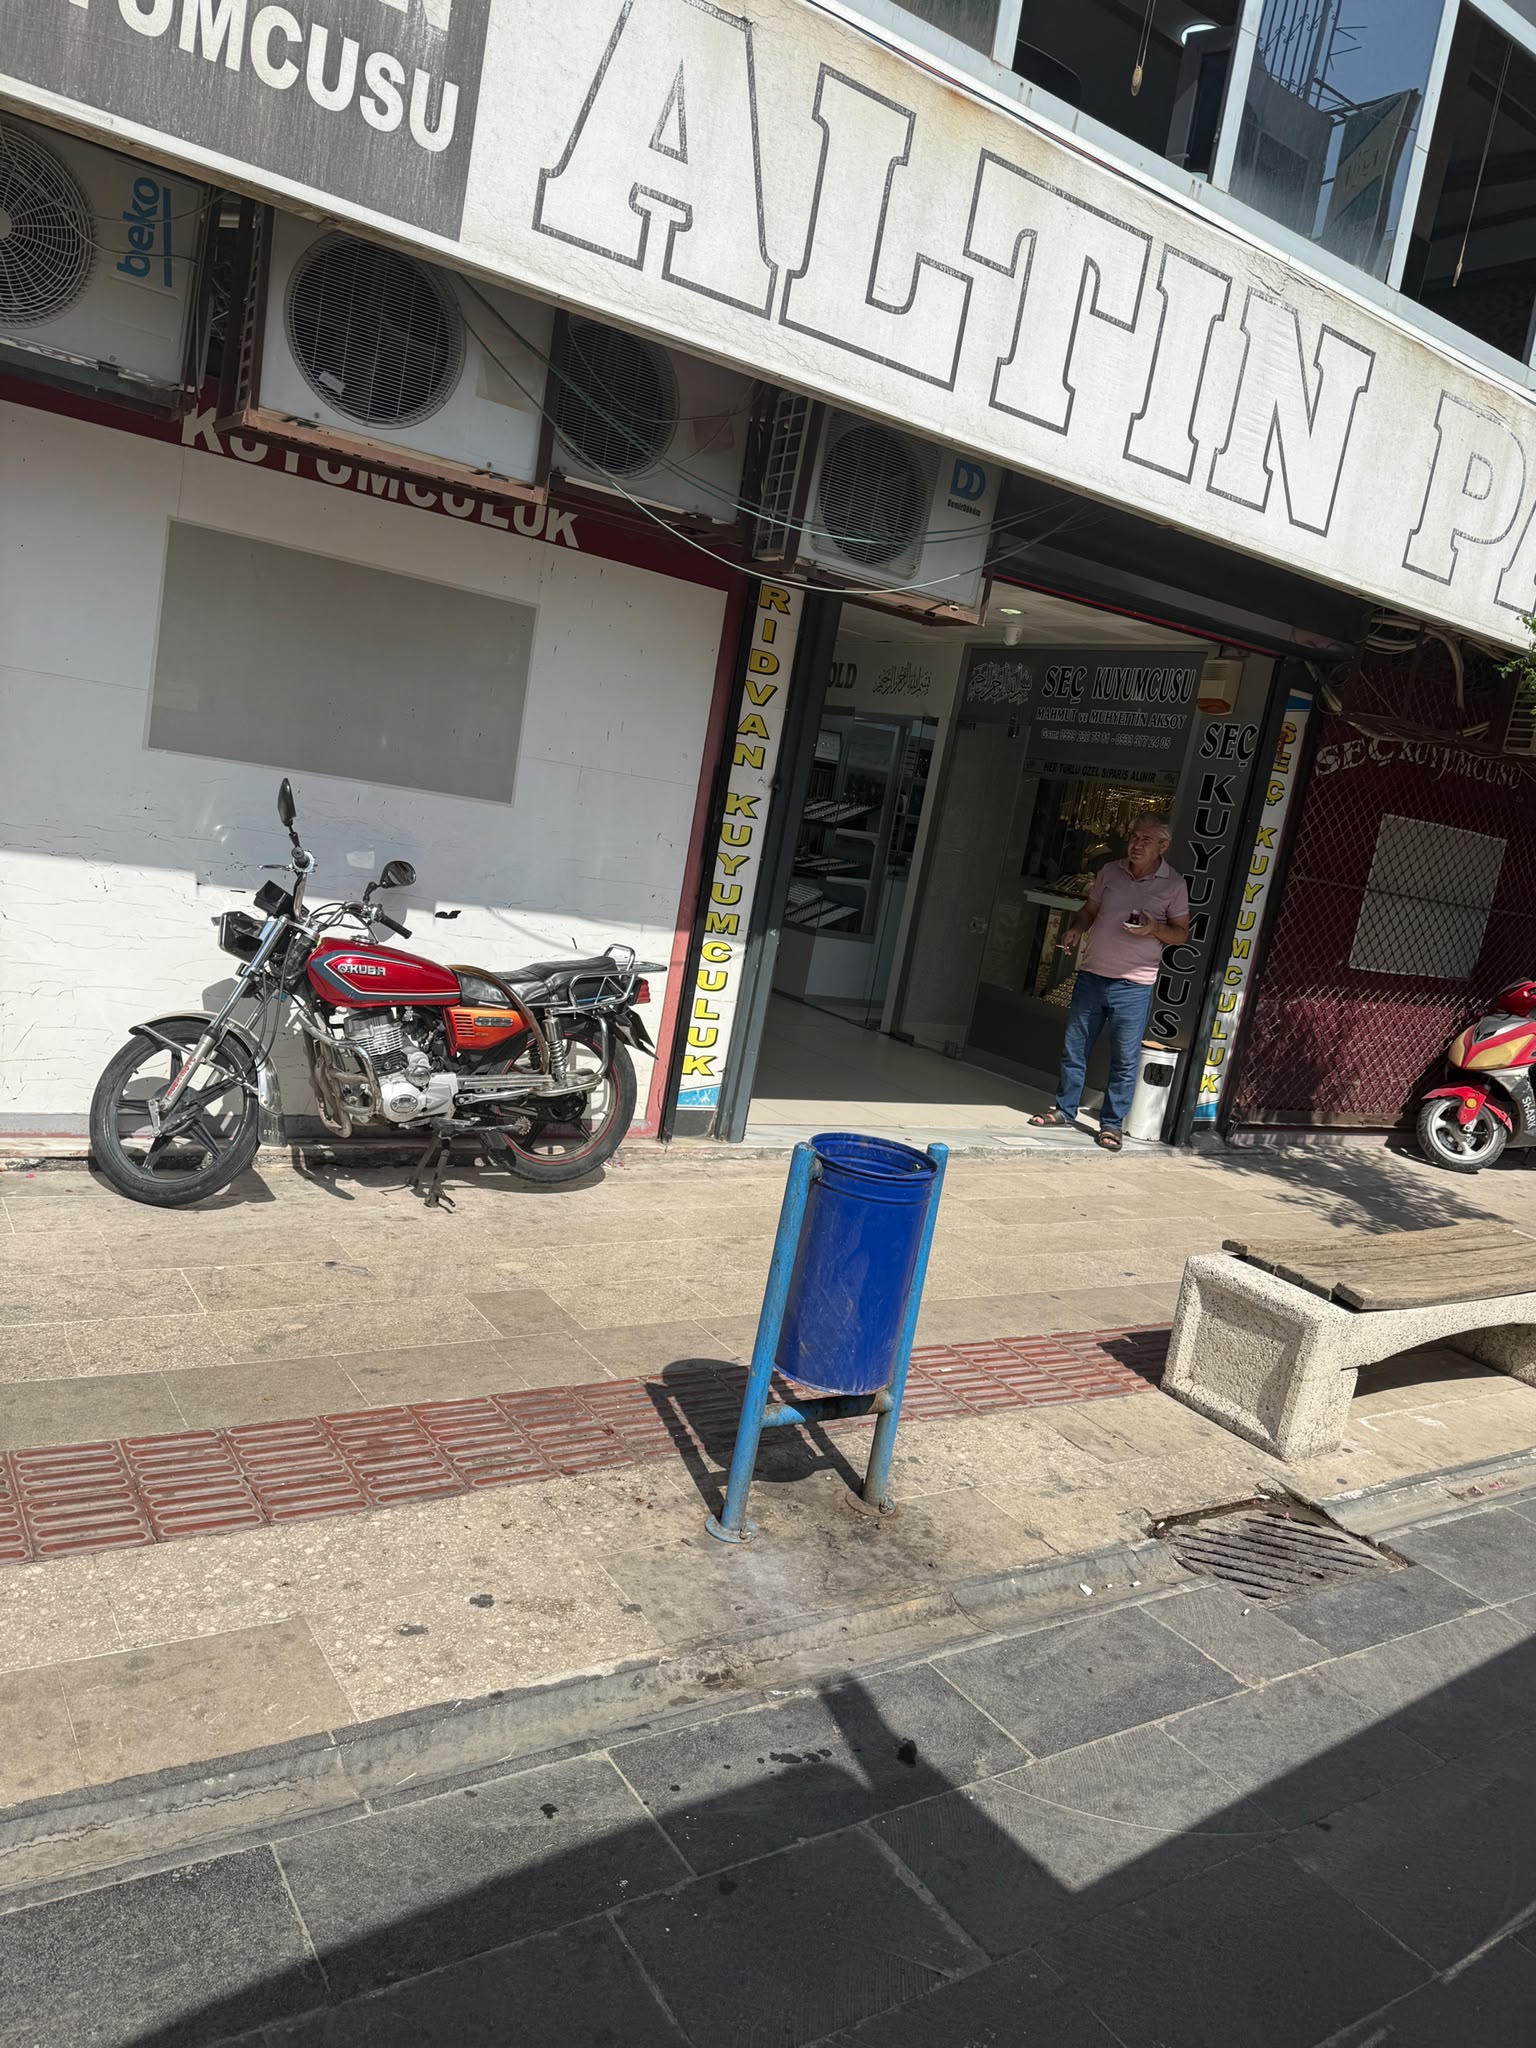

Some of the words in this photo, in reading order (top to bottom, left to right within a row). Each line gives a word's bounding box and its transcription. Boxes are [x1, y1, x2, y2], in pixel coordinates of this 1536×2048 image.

[117, 177, 160, 277] beko
[532, 0, 1376, 536] ALTIN
[733, 583, 791, 770] RIDVAN
[1042, 665, 1087, 704] SEÇ
[1091, 667, 1197, 703] KUYUMCUSU
[1036, 707, 1079, 722] MAHMUT
[1148, 713, 1187, 729] AKSOY
[1200, 722, 1259, 768] SEÇ
[1314, 738, 1394, 776] SEÇ
[1399, 741, 1523, 789] KUYUMCUSU
[350, 964, 386, 977] KUBA
[681, 791, 761, 1077] KUYUMCULUK
[1199, 826, 1278, 1094] KUYUMCULUK
